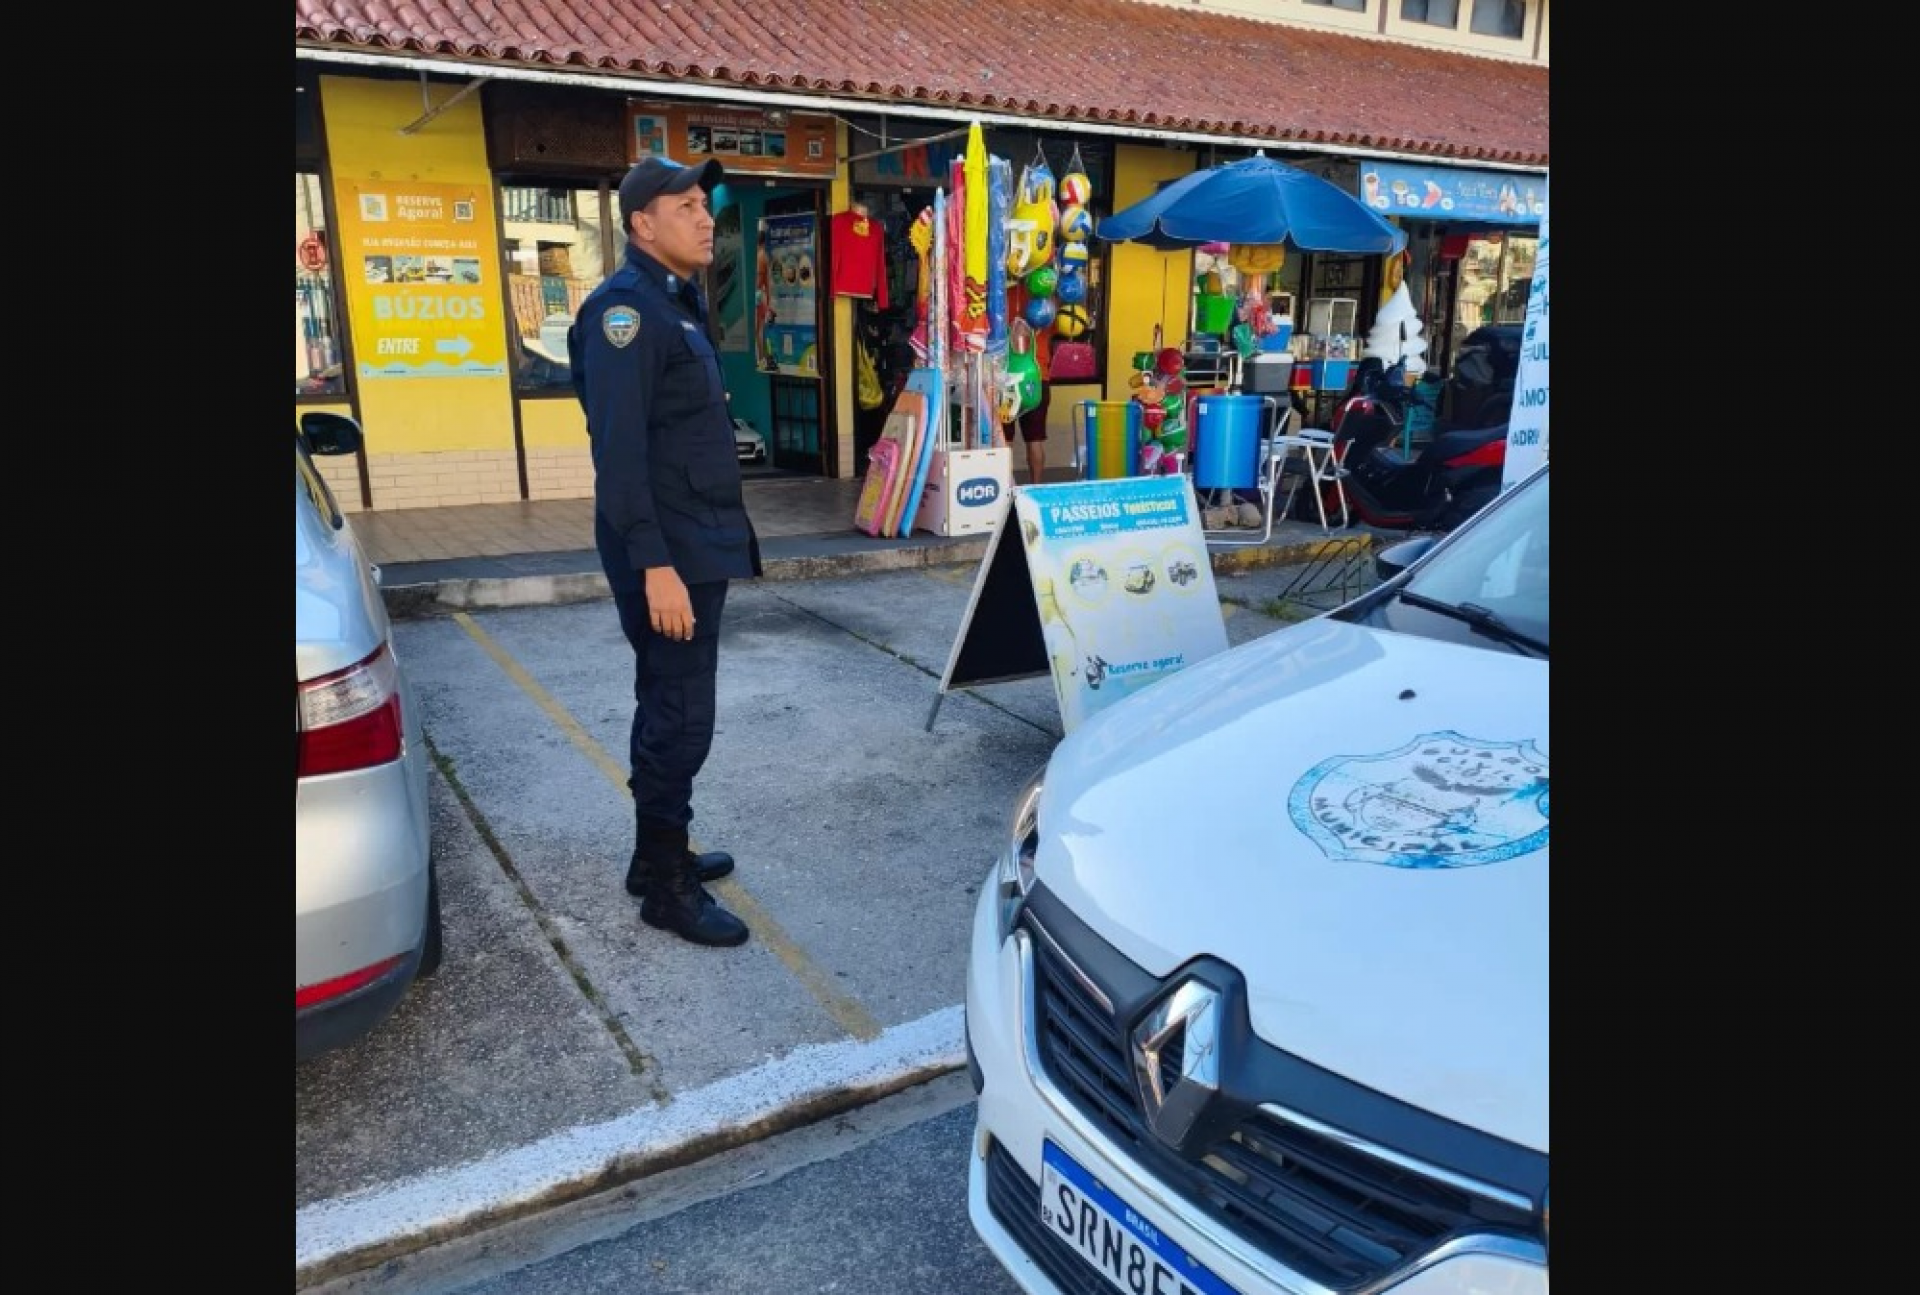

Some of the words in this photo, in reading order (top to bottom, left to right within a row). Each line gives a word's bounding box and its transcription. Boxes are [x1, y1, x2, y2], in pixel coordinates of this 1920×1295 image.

[396, 195, 443, 206] RESERVE
[398, 206, 443, 221] Agora!
[373, 289, 485, 320] BÚZIOS
[377, 337, 419, 355] ENTRE
[960, 485, 996, 501] MOR
[1050, 501, 1120, 523] PASSEIOS
[1313, 796, 1482, 853] MUNICIPAL
